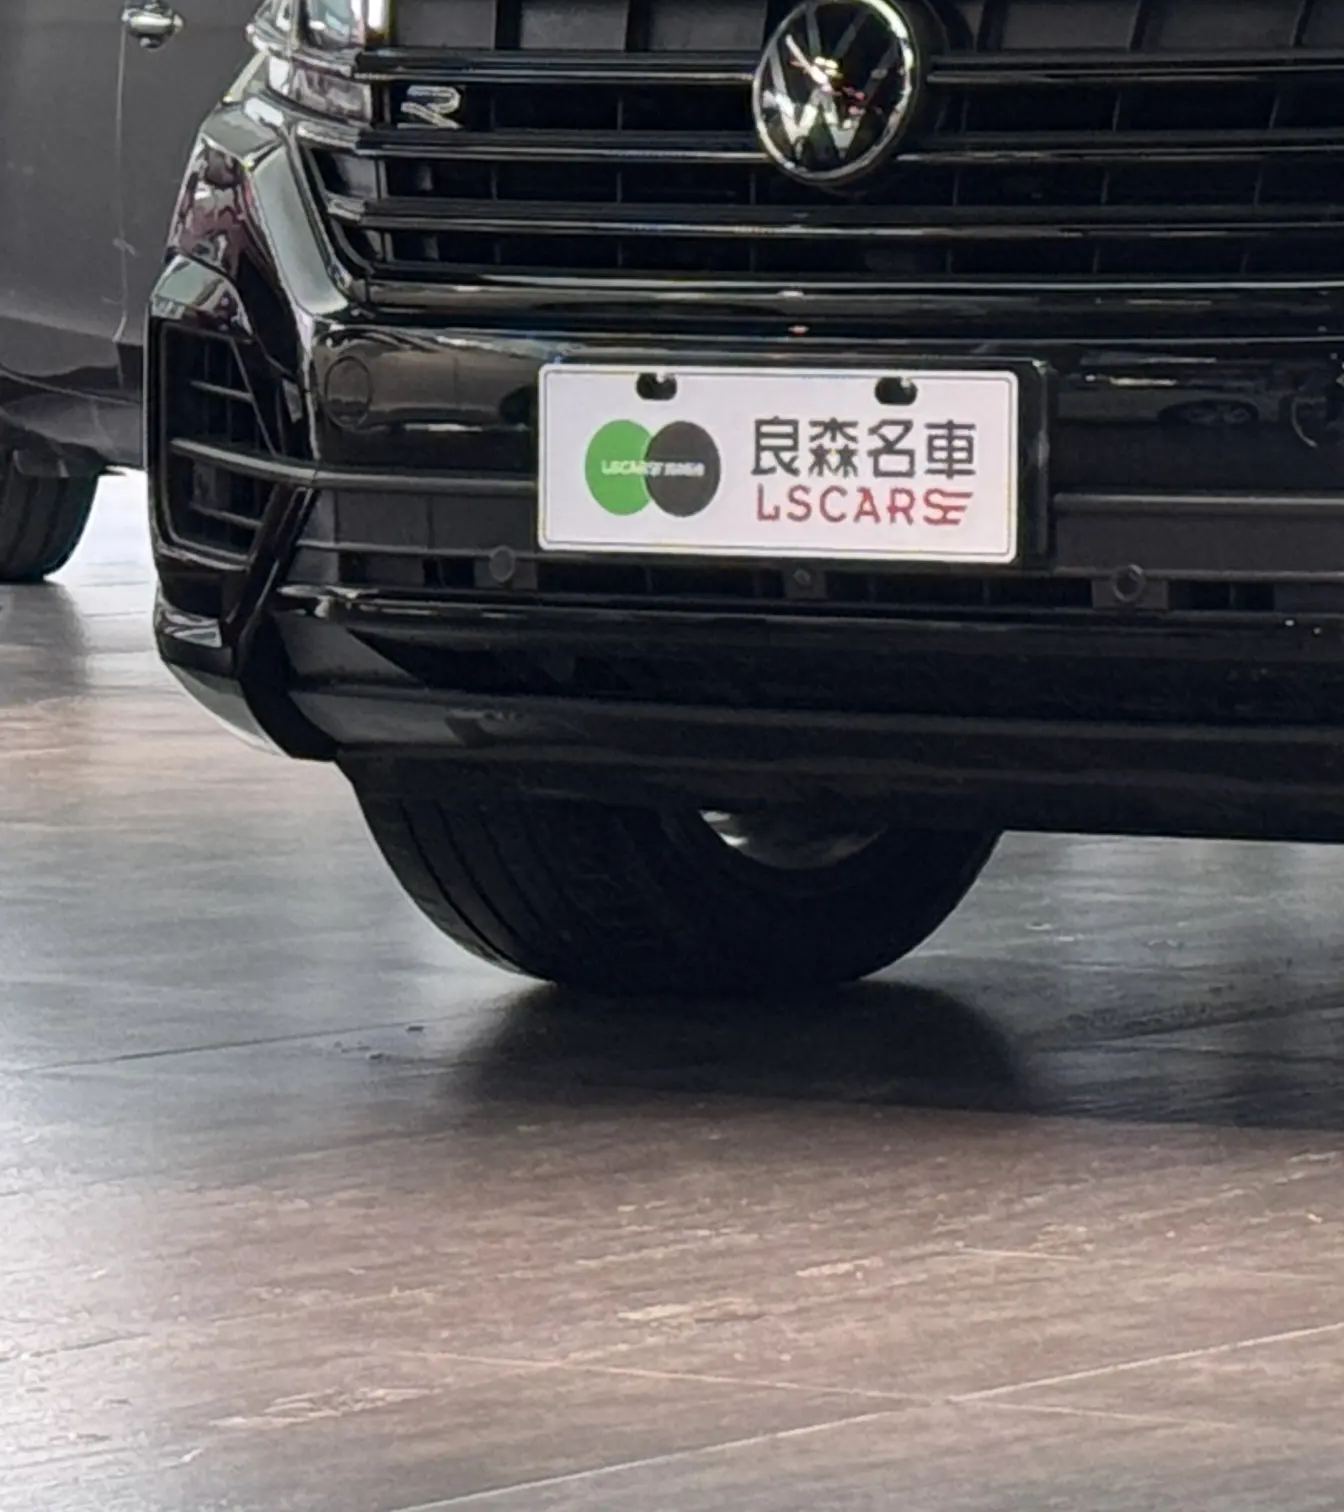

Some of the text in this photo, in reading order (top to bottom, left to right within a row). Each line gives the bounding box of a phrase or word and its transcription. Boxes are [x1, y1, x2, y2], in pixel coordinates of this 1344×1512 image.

[749, 415, 977, 480] 良森名車
[755, 483, 974, 527] LSCARS
